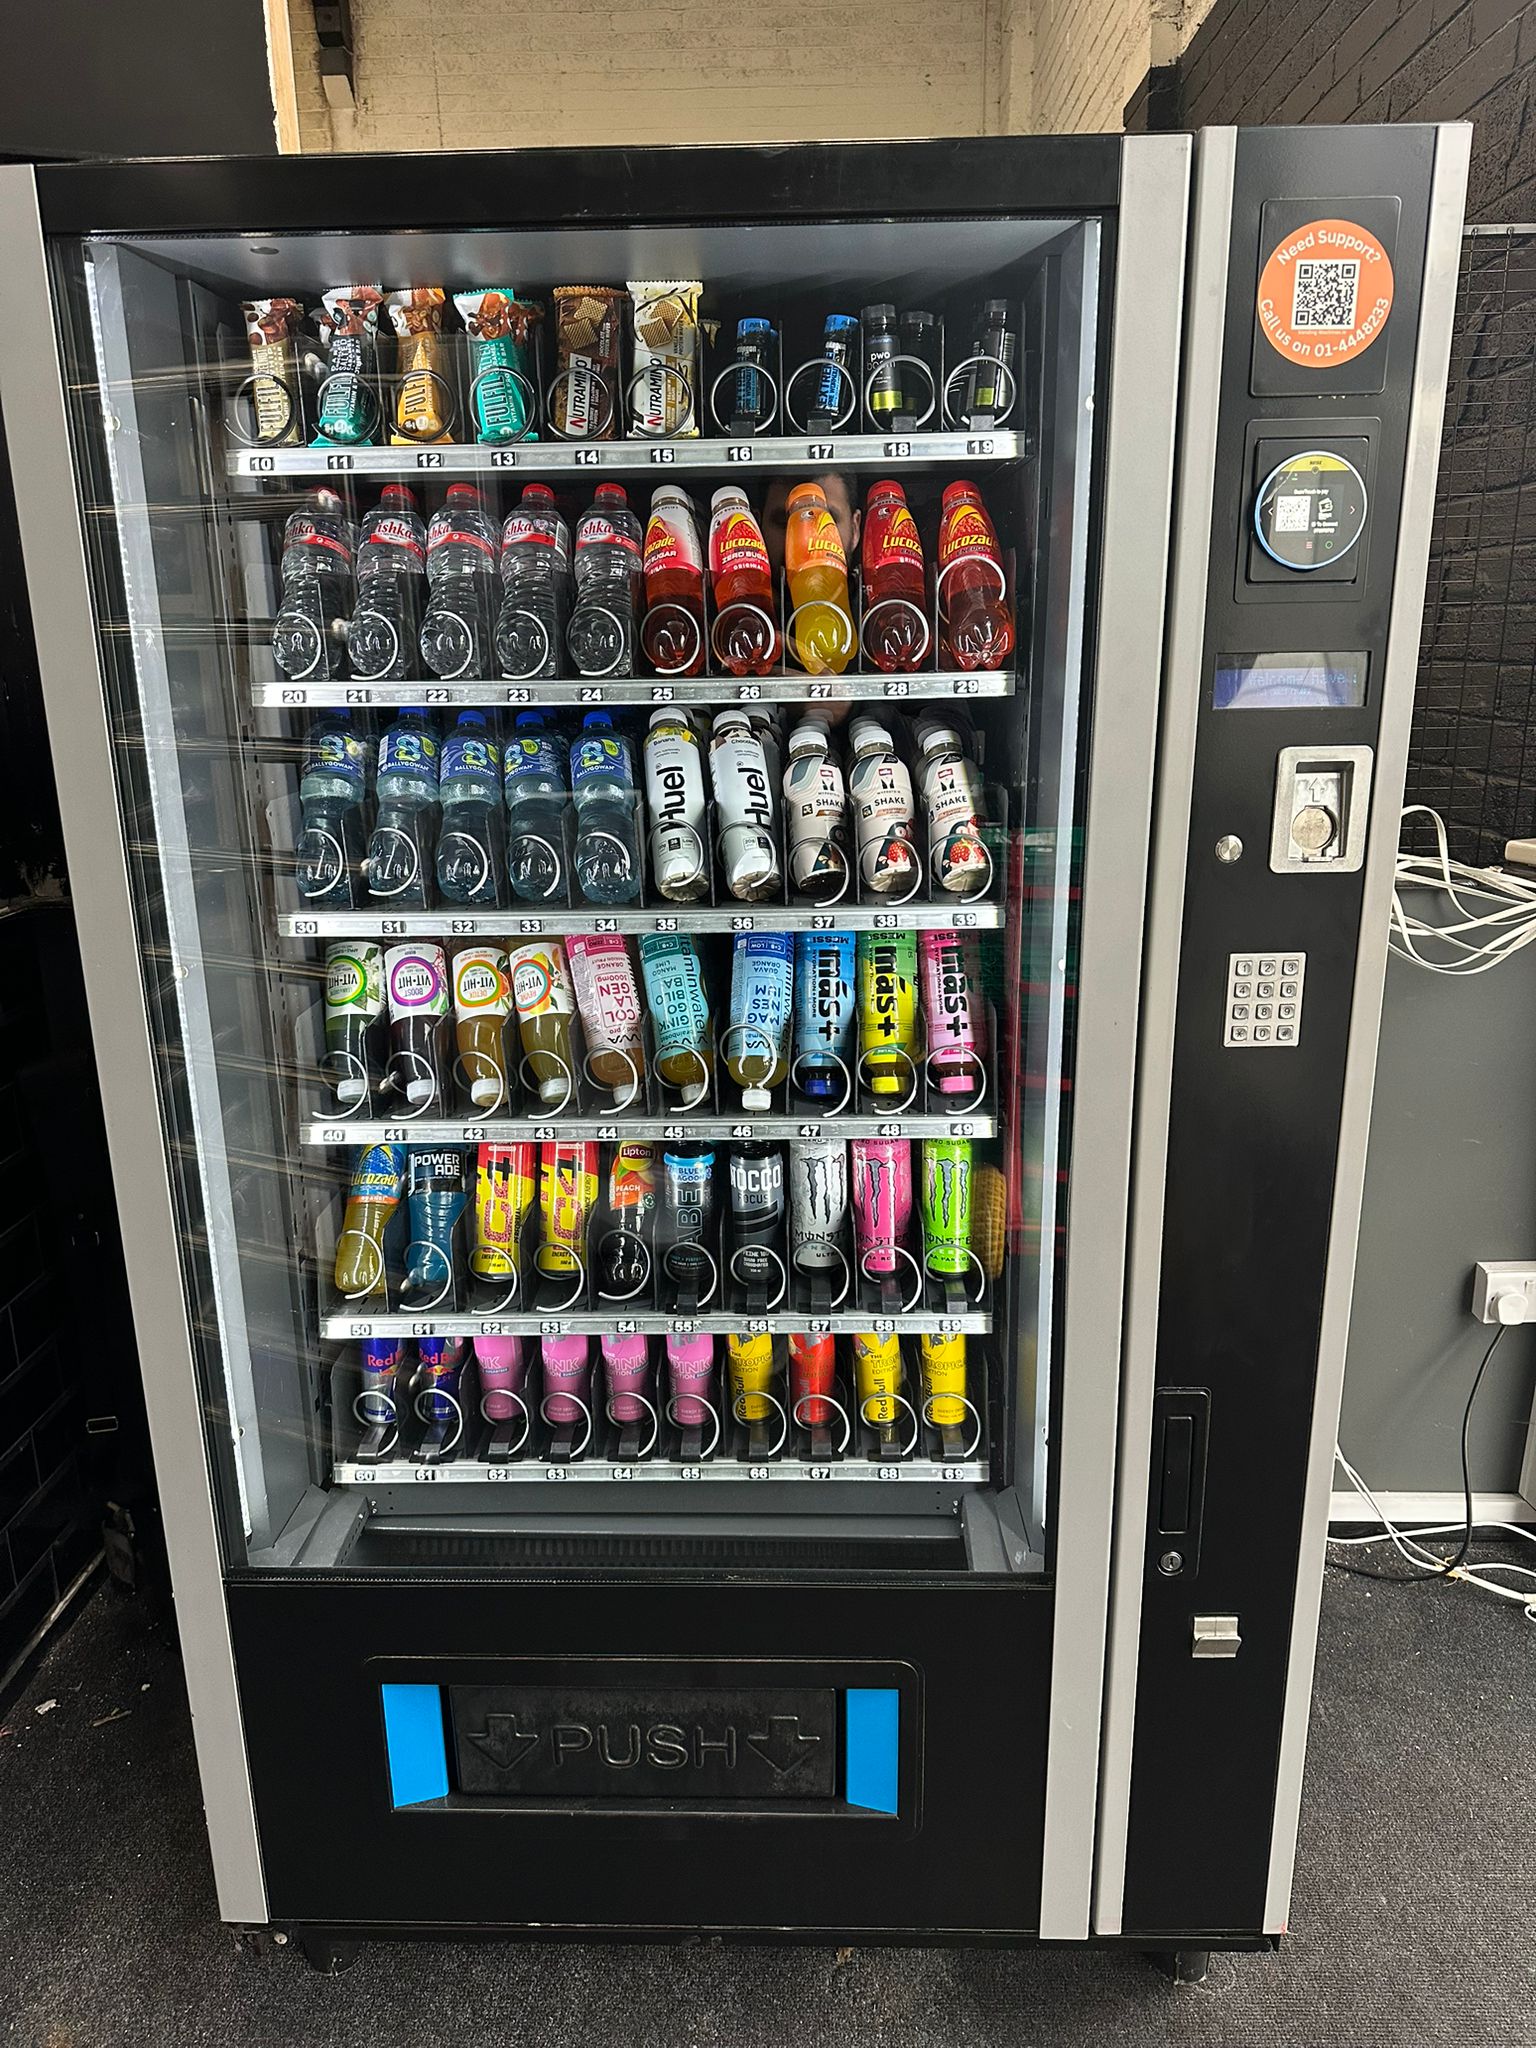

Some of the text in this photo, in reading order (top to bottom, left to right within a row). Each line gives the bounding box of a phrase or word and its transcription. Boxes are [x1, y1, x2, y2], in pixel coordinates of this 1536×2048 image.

[1276, 229, 1382, 266] Need Support?
[1260, 297, 1389, 358] Call us on 01-4448233
[870, 351, 891, 362] pwo
[810, 446, 832, 459] 17
[887, 444, 909, 456] 18
[971, 441, 994, 454] 19
[493, 453, 515, 465] 13
[577, 452, 598, 464] 14
[652, 450, 674, 462] 15
[729, 448, 751, 460] 16
[251, 458, 272, 470] 10
[329, 457, 348, 469] 11
[418, 455, 440, 467] 12
[377, 520, 416, 539] ishka
[722, 552, 745, 564] ZERO
[739, 687, 760, 698] 26
[810, 685, 831, 697] 27
[887, 683, 908, 695] 28
[956, 681, 979, 693] 29
[284, 691, 304, 702] 20
[348, 690, 367, 702] 21
[428, 690, 448, 702] 22
[508, 689, 529, 702] 23
[581, 689, 603, 701] 24
[652, 688, 673, 699] 25
[653, 736, 676, 746] Banana
[311, 761, 354, 772] BALLYGOWAN
[387, 761, 430, 772] BALLYGOWAN
[454, 764, 496, 777] BALLYGOWAN
[576, 765, 615, 779] BALLYGOWAN
[656, 766, 686, 834] Huel
[737, 767, 772, 831] Huel
[874, 797, 906, 807] SHAKE
[935, 795, 968, 811] SHAKE
[657, 919, 677, 930] 35
[733, 918, 753, 929] 36
[814, 917, 834, 928] 37
[876, 916, 896, 927] 38
[956, 914, 976, 925] 39
[296, 922, 316, 933] 30
[383, 922, 400, 933] 31
[453, 922, 473, 933] 32
[521, 921, 541, 932] 33
[596, 920, 616, 931] 34
[596, 962, 625, 970] ORANGE
[654, 959, 671, 969] LIME
[751, 960, 781, 969] ORANGE
[651, 965, 678, 976] MANGO
[753, 966, 779, 974] GUAVA
[597, 974, 629, 983] 1000mg
[663, 976, 684, 989] BA
[599, 982, 631, 997] GEN
[613, 994, 634, 1008] LA
[655, 988, 686, 1005] BILO
[667, 1005, 688, 1015] GO
[752, 999, 780, 1012] NES
[605, 1008, 637, 1023] COL
[747, 1012, 780, 1026] MAG
[658, 1016, 690, 1032] GINK
[385, 1129, 404, 1140] 41
[463, 1129, 483, 1139] 42
[535, 1128, 555, 1139] 43
[597, 1127, 617, 1138] 44
[665, 1127, 684, 1138] 45
[732, 1127, 752, 1137] 46
[800, 1126, 819, 1137] 47
[881, 1125, 900, 1136] 48
[953, 1124, 973, 1135] 49
[323, 1130, 343, 1141] 40
[622, 1146, 652, 1157] Lipton
[414, 1153, 460, 1168] POWER
[435, 1164, 461, 1176] ADE
[678, 1167, 699, 1175] BLUE
[615, 1184, 641, 1193] PEACH
[351, 1324, 370, 1335] 50
[414, 1324, 430, 1334] 51
[482, 1323, 500, 1333] 52
[540, 1323, 559, 1333] 53
[618, 1322, 636, 1332] 54
[674, 1322, 693, 1332] 55
[749, 1321, 768, 1331] 56
[811, 1321, 830, 1331] 57
[875, 1320, 894, 1331] 58
[942, 1320, 961, 1330] 59
[367, 1352, 394, 1367] Red
[876, 1399, 889, 1420] Red
[355, 1471, 374, 1481] 60
[416, 1470, 434, 1480] 61
[488, 1470, 507, 1480] 62
[547, 1469, 565, 1480] 63
[613, 1469, 632, 1479] 64
[681, 1468, 700, 1479] 65
[750, 1468, 768, 1479] 66
[811, 1468, 830, 1479] 67
[879, 1468, 898, 1479] 68
[945, 1468, 964, 1479] 69
[550, 1724, 738, 1770] PUSH
